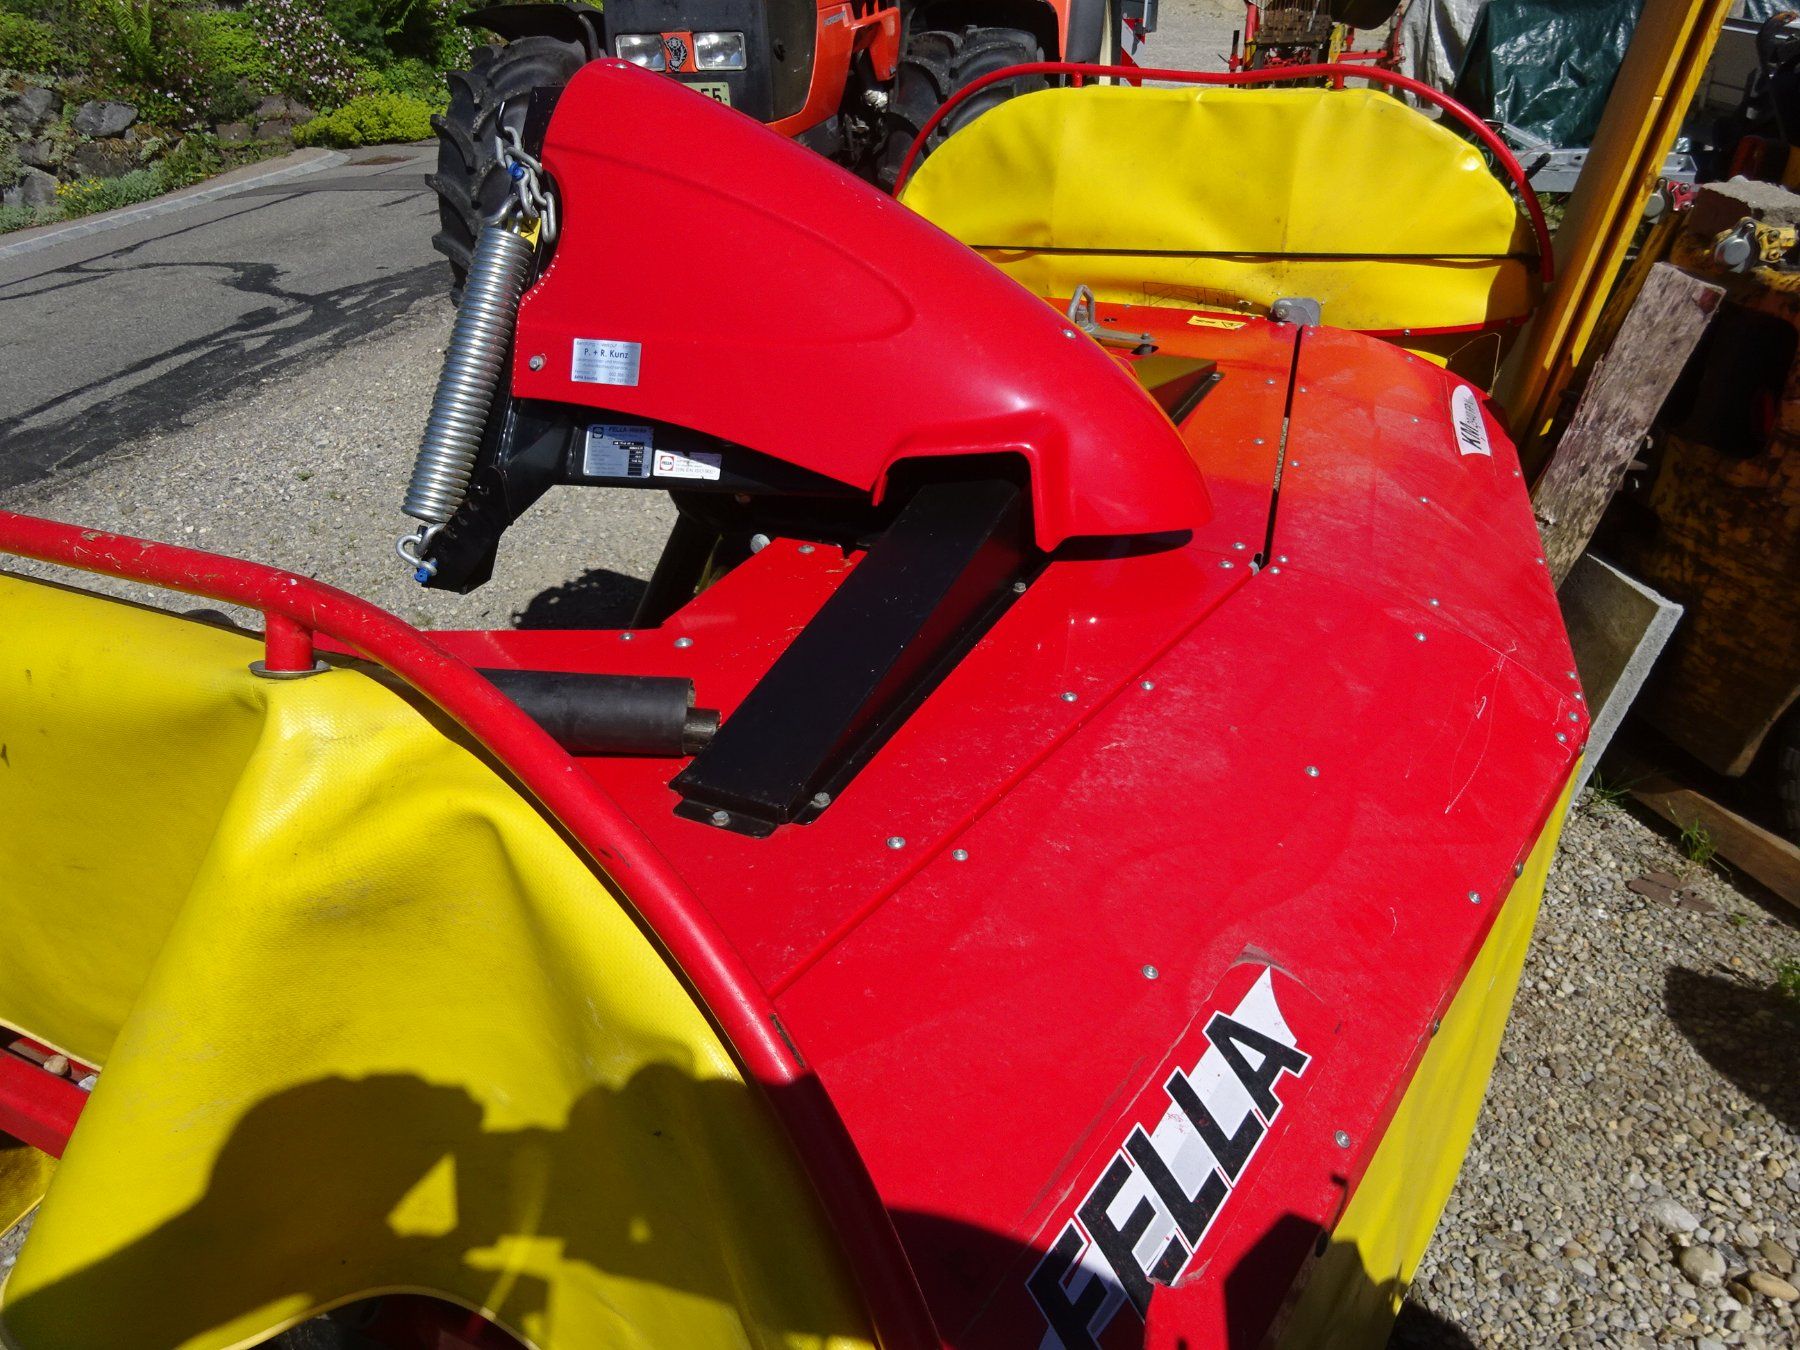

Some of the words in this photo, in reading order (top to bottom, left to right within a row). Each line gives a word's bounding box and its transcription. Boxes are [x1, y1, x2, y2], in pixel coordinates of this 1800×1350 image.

[584, 348, 591, 356] P.
[600, 349, 608, 358] R.
[609, 349, 629, 359] Kunz
[1460, 421, 1482, 450] KM
[1025, 1010, 1311, 1350] FELLA
